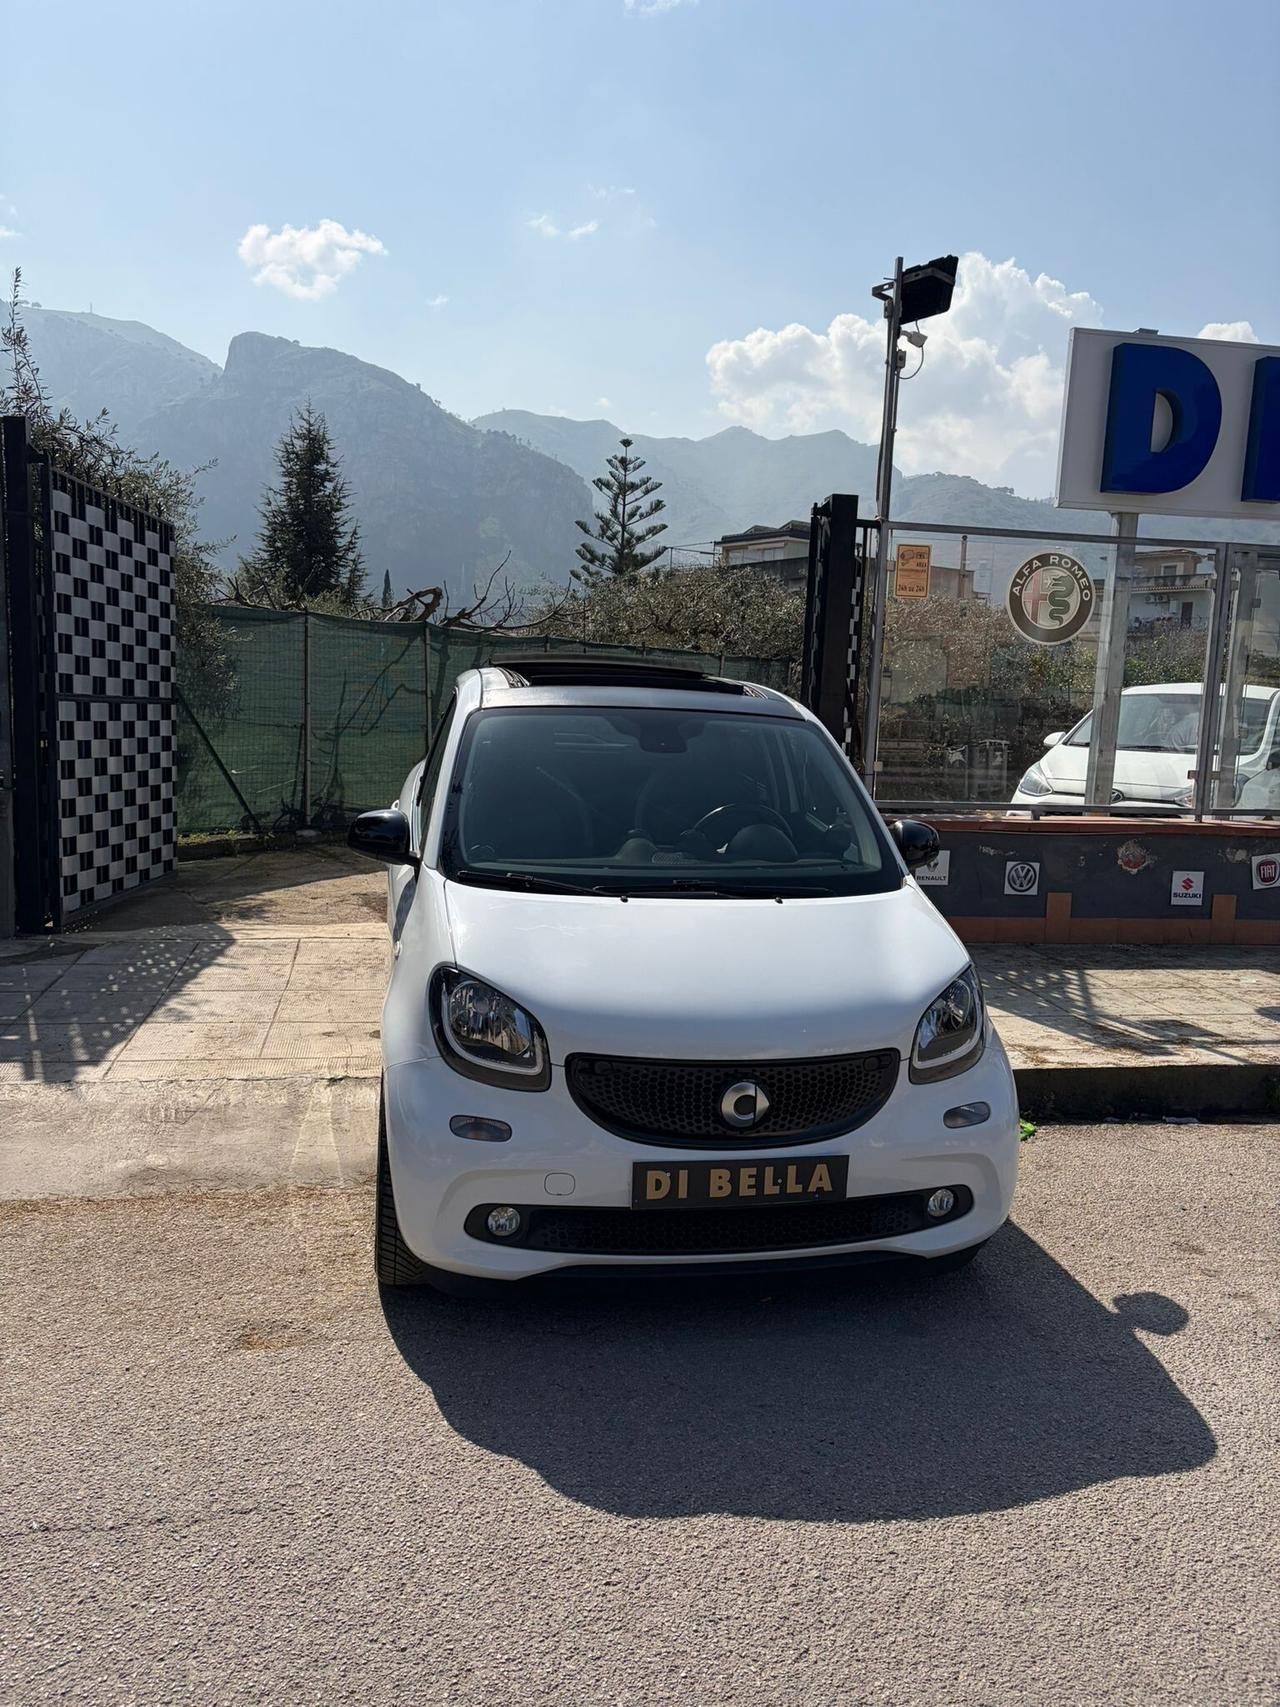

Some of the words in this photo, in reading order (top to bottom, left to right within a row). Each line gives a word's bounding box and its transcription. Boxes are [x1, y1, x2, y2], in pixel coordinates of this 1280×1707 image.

[1100, 343, 1280, 504] DI
[1013, 559, 1042, 596] ALFA
[1049, 555, 1091, 601] ROMEO
[1260, 864, 1276, 879] FIAT
[646, 1168, 689, 1201] DI
[709, 1163, 833, 1198] BELLA
